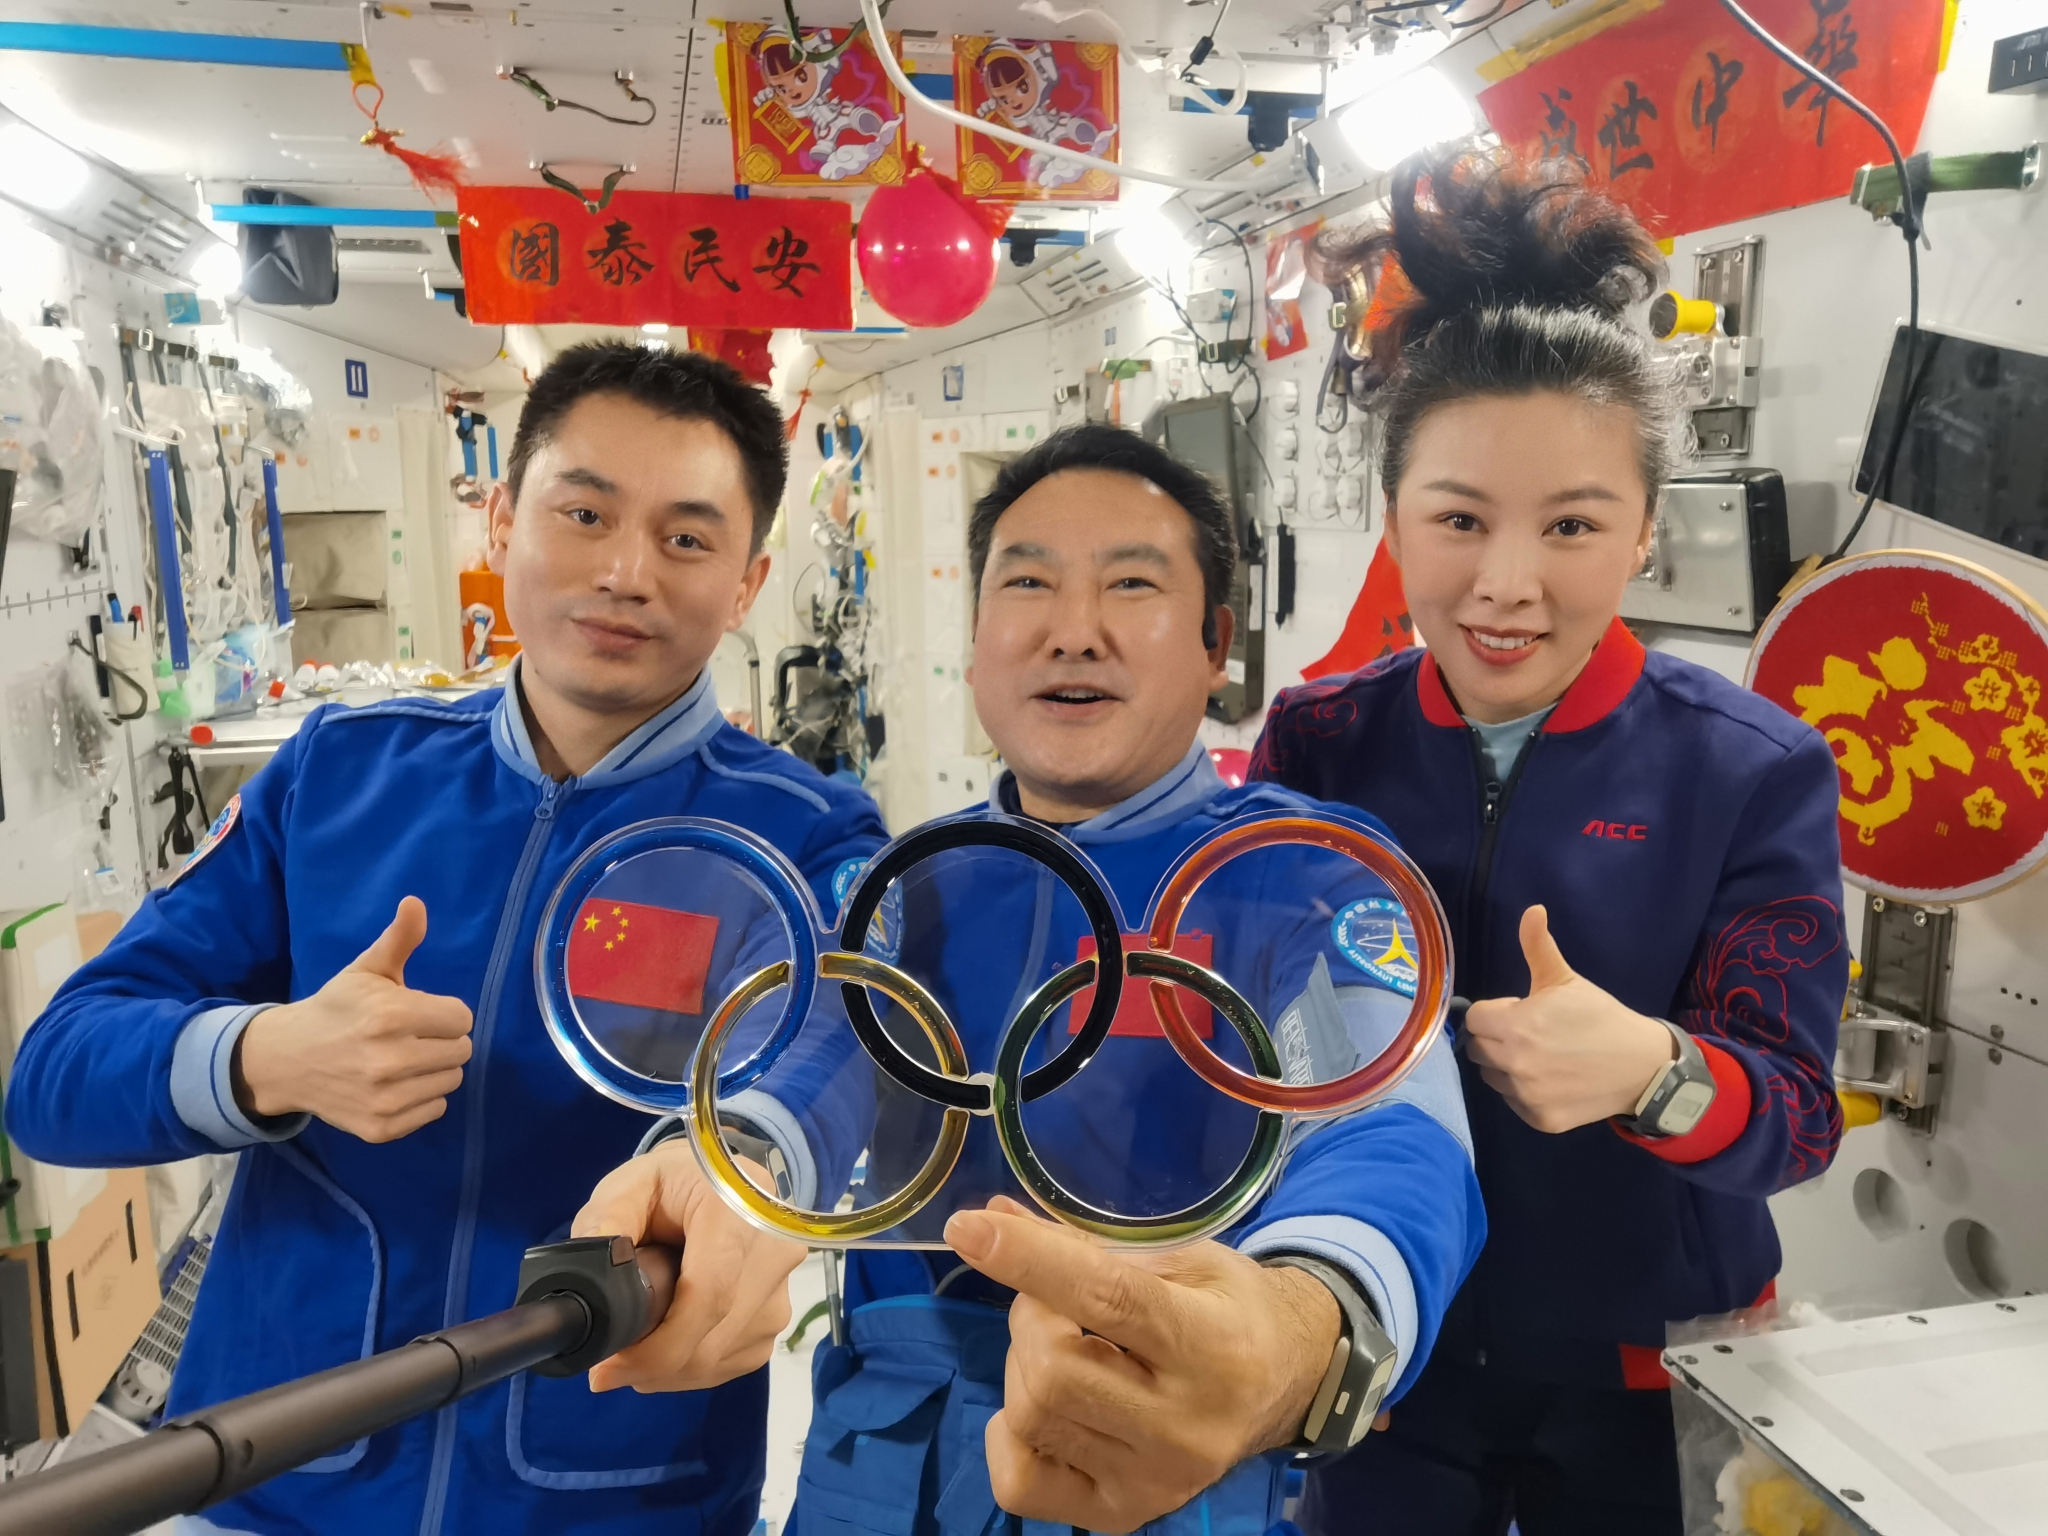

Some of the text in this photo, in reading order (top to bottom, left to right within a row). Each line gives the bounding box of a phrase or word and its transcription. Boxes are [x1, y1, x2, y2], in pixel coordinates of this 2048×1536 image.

[510, 216, 822, 298] 國泰民安
[1581, 819, 1648, 840] ACC
